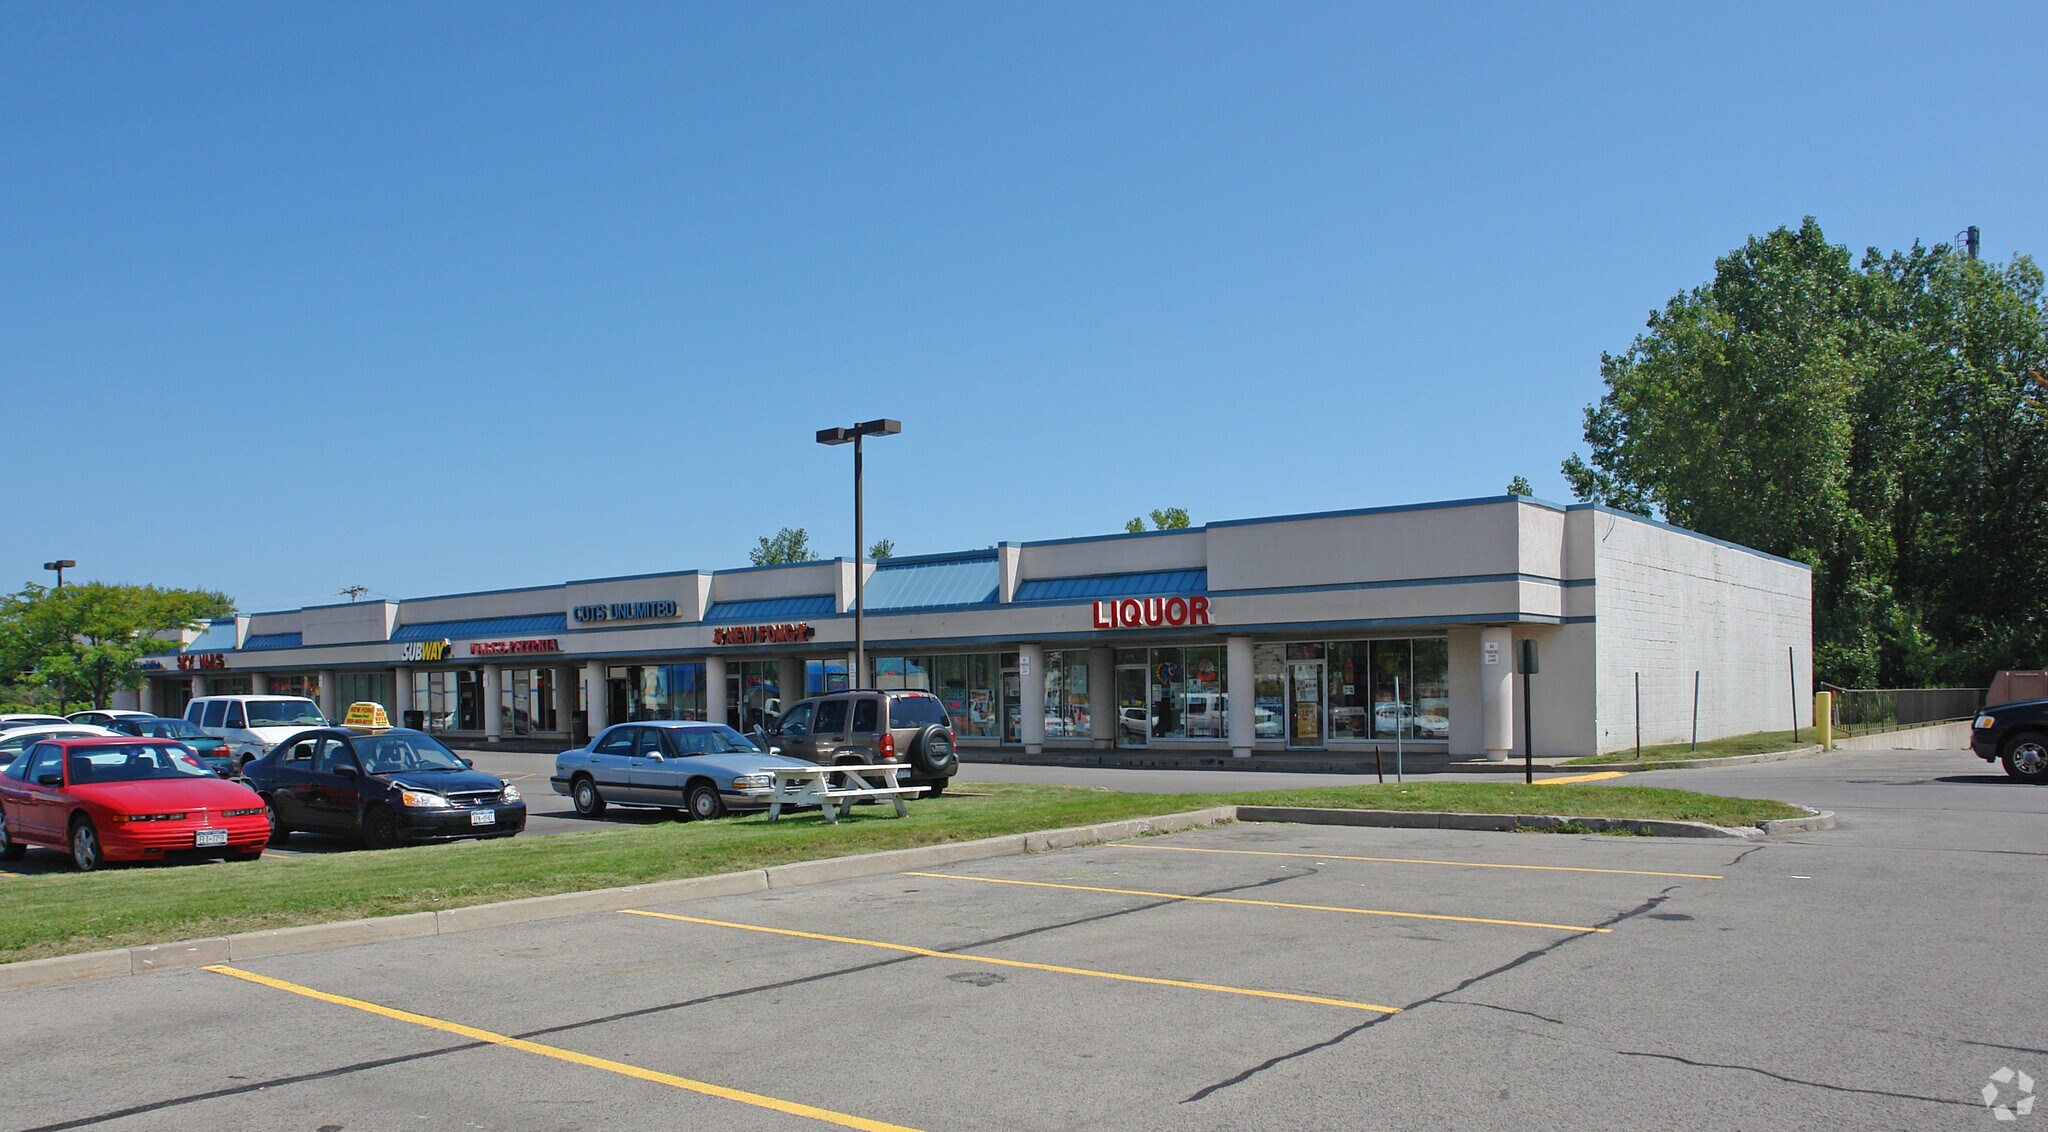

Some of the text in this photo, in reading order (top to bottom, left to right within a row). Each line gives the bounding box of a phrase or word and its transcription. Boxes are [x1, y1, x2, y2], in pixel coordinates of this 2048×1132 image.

[573, 600, 676, 622] CUTS UNLIMITED
[1092, 596, 1210, 628] LIQUOR
[726, 626, 756, 644] NEW
[758, 623, 796, 643] FONG
[401, 639, 449, 662] SUBWAY
[508, 639, 559, 654] PIZZERIA
